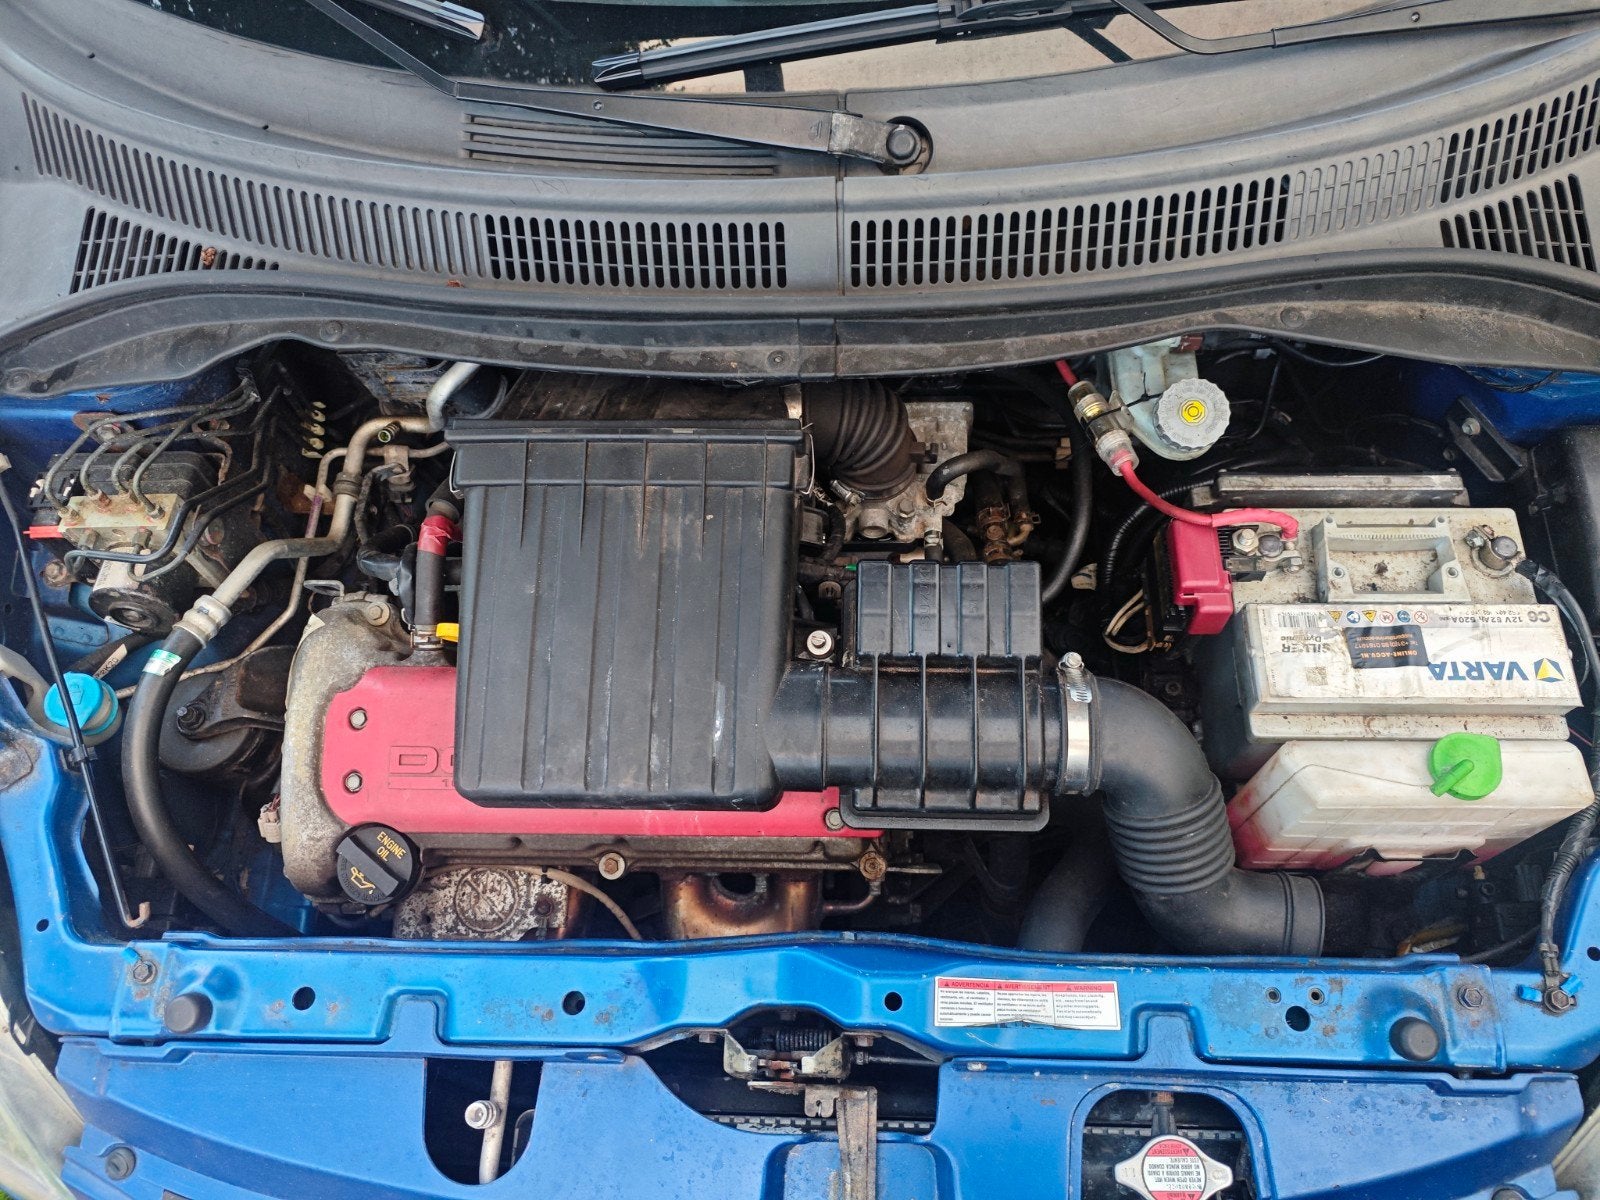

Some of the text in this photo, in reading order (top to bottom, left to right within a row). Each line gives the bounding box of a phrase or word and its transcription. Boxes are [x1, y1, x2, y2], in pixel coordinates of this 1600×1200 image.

[1527, 610, 1551, 623] C6
[1281, 634, 1322, 643] Dynmic
[1427, 661, 1530, 681] VARTA
[376, 831, 407, 860] ENGINE
[376, 846, 390, 862] OIL
